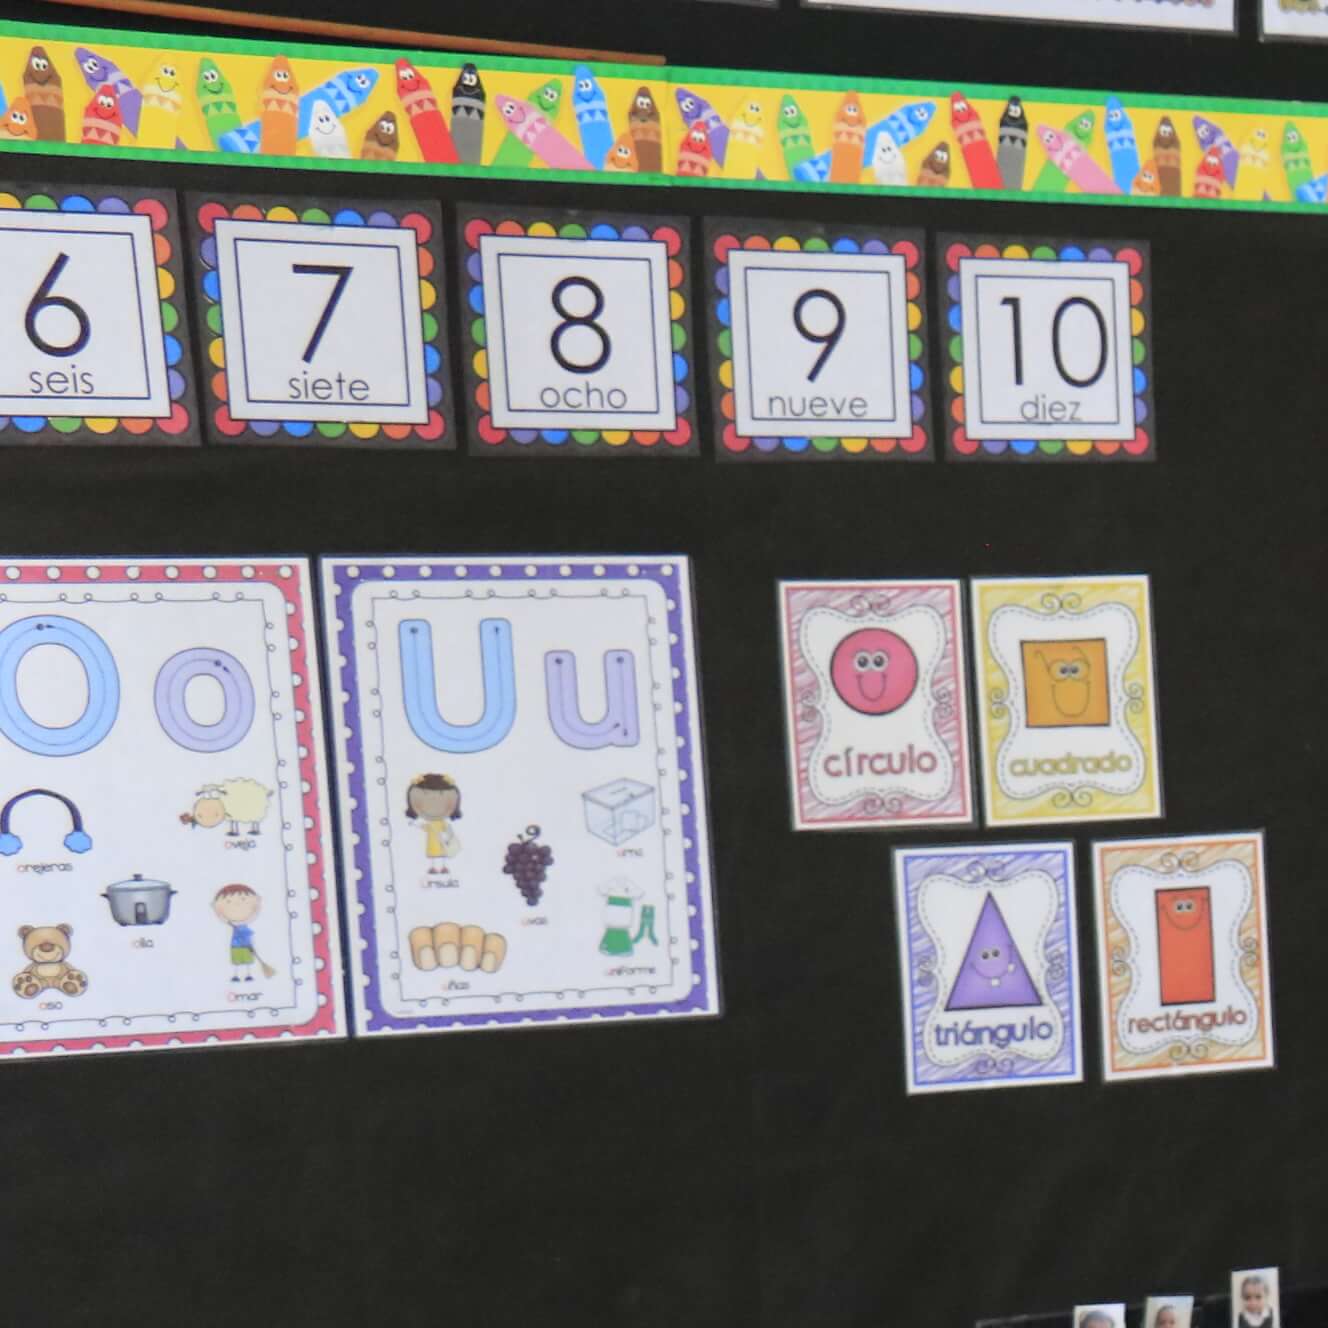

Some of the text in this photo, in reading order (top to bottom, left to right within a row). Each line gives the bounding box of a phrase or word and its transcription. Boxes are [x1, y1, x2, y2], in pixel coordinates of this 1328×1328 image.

[25, 251, 92, 358] 6
[291, 262, 355, 364] 7
[549, 275, 612, 374] 8
[792, 288, 847, 383] 9
[1000, 296, 1109, 388] 10
[29, 364, 95, 395] seis
[287, 370, 371, 402] siete
[539, 382, 628, 410] ocho
[767, 394, 869, 418] nueve
[1019, 394, 1083, 422] diez
[0, 614, 256, 757] O o
[398, 617, 641, 754] U u
[822, 743, 939, 779] círculo
[1008, 750, 1133, 779] cuadrado
[934, 1016, 1054, 1049] triángulo
[1127, 1004, 1248, 1038] rectángulo
